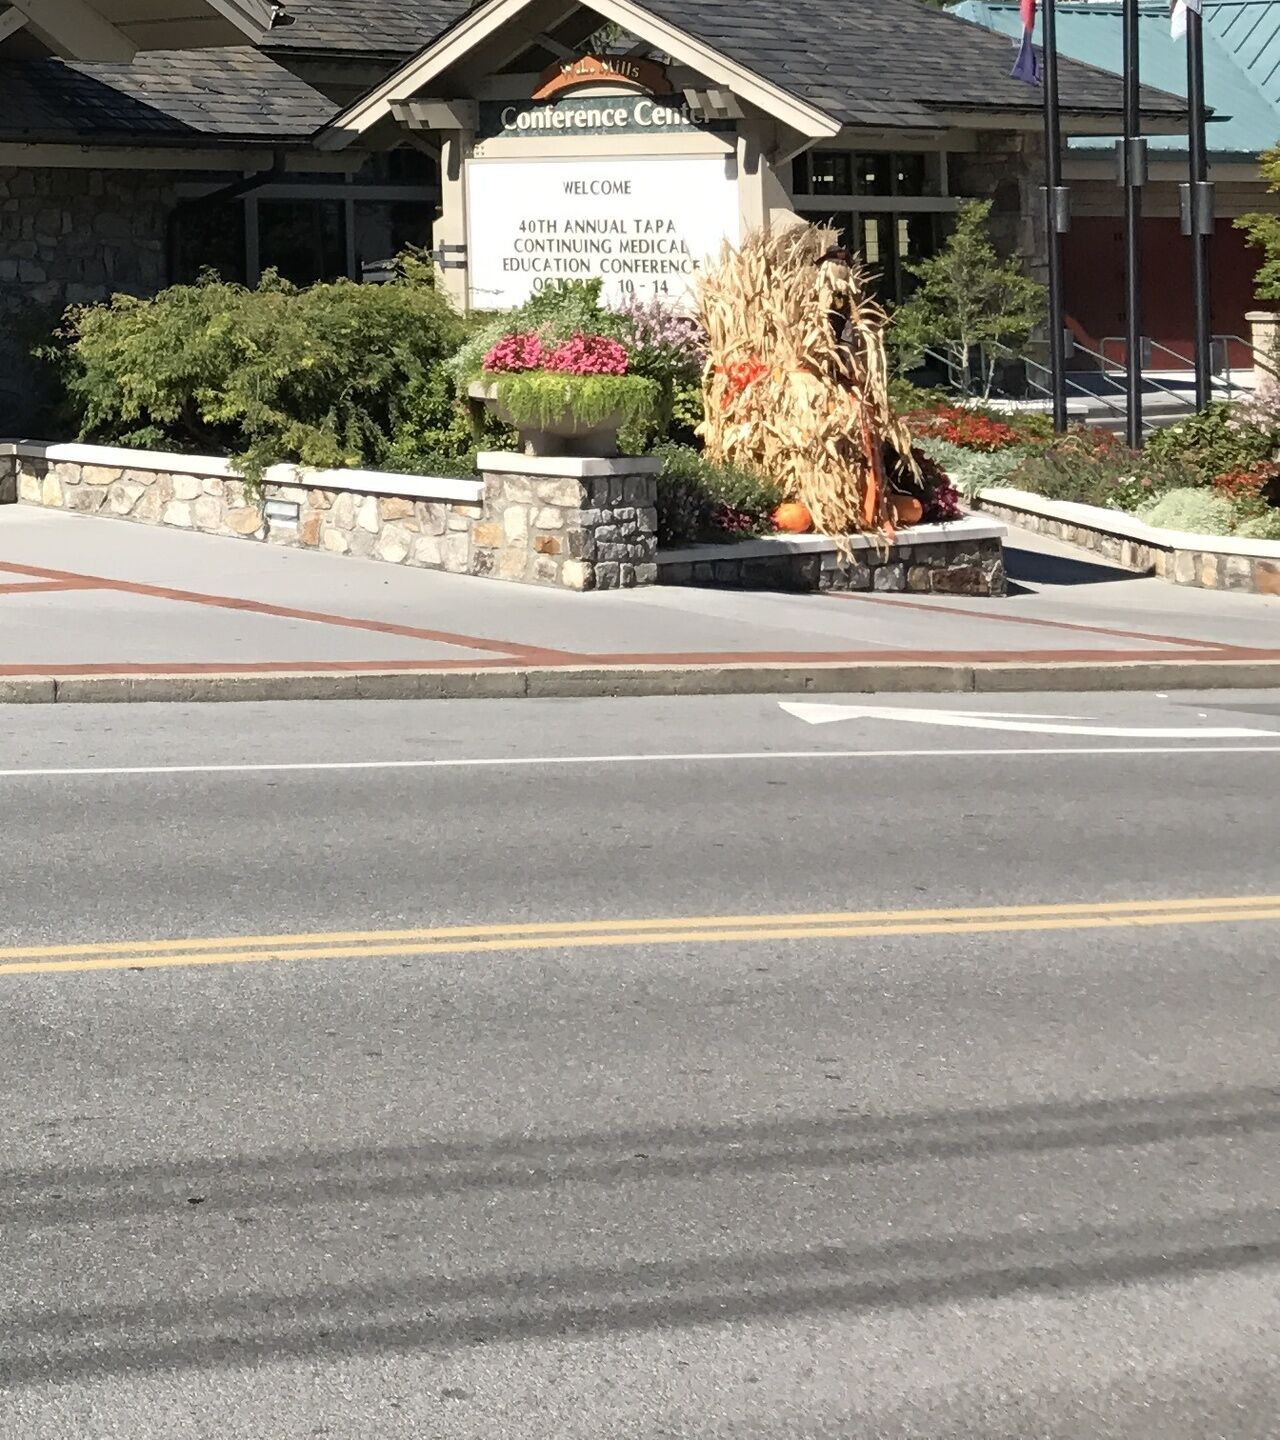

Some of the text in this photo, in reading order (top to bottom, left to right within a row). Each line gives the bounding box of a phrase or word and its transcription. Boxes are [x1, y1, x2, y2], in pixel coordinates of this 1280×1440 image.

[600, 59, 640, 78] Mills
[500, 100, 710, 130] Conference Center
[563, 180, 632, 195] WELCOME
[518, 219, 676, 234] 40TH ANNUAL TAPA
[513, 238, 689, 254] CONTINUING MEDICAL
[502, 257, 701, 274] EDUCATION CONFERENCE
[617, 279, 634, 294] 10
[652, 279, 669, 294] 14
